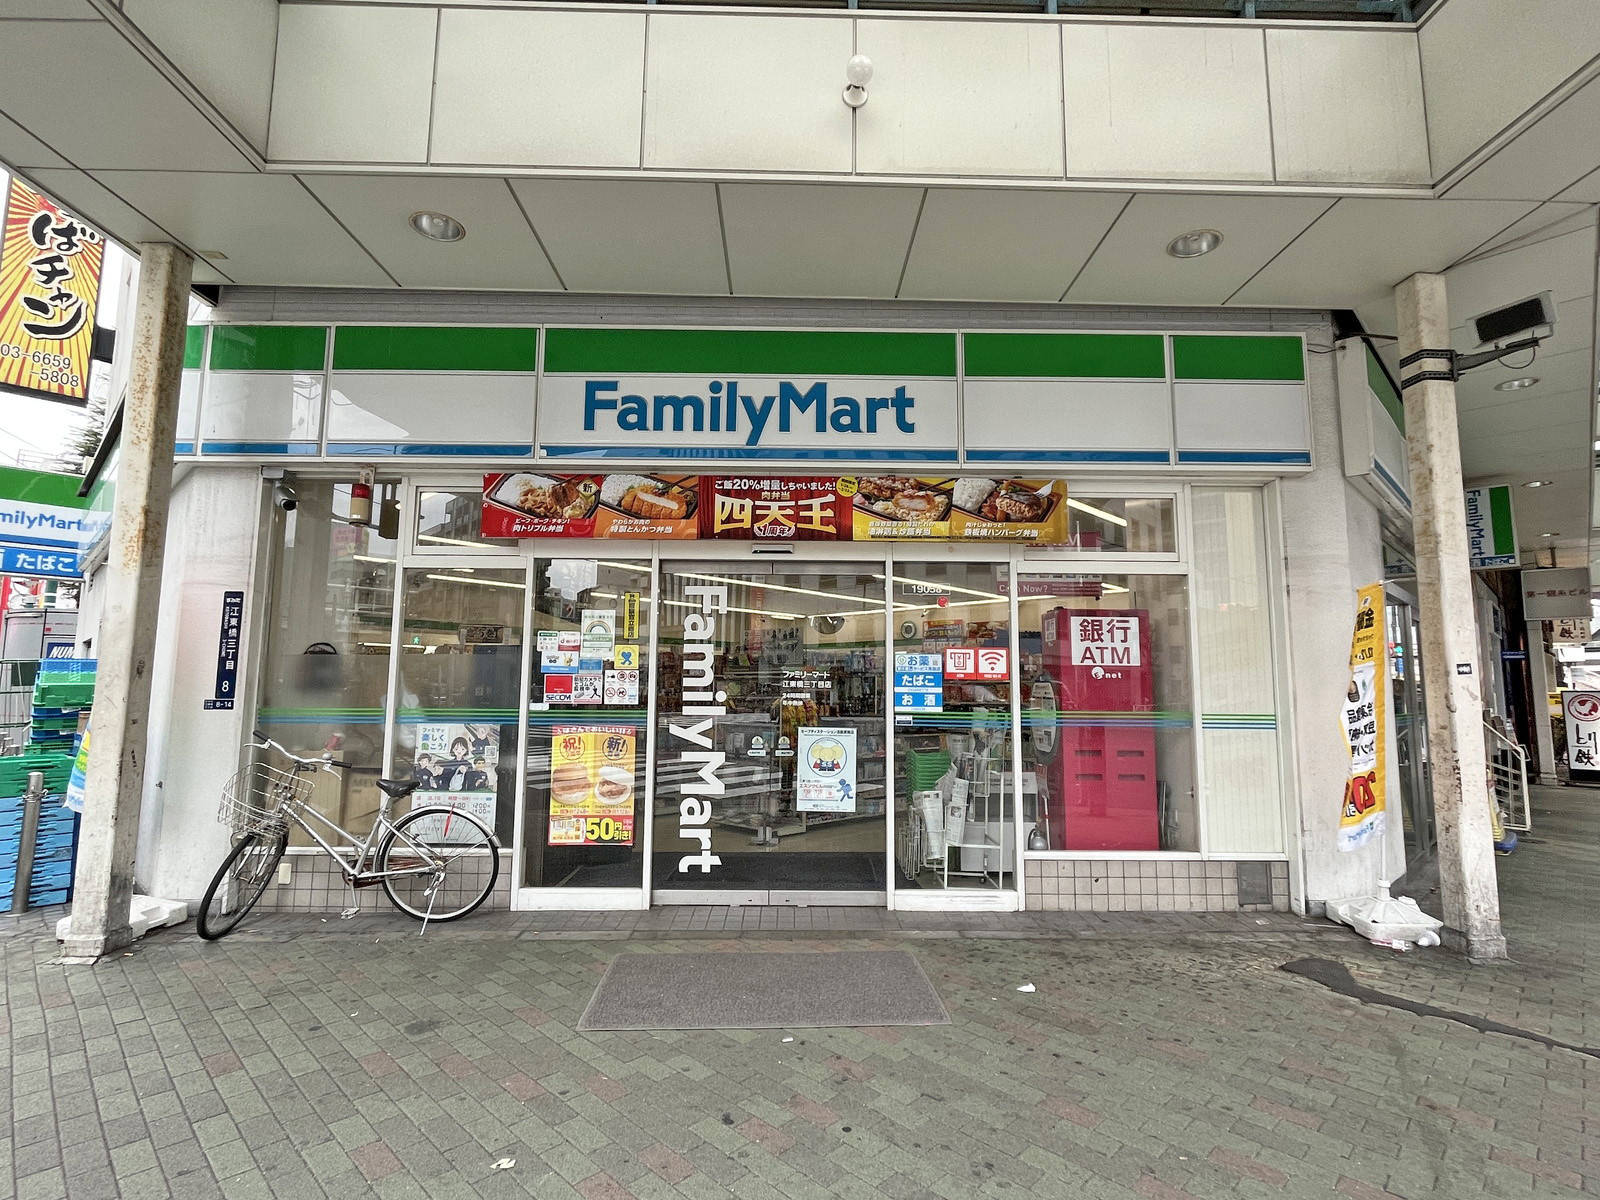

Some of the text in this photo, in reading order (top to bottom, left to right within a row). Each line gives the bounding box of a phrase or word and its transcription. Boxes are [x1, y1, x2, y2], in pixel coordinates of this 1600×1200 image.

[0, 343, 72, 370] 03-6659
[30, 367, 80, 389] -5808
[583, 380, 916, 447] FamilyMart
[582, 482, 593, 493] 新
[715, 479, 836, 490] ご飯20%増量しちゃいました!
[761, 491, 791, 500] 肉弁当
[714, 493, 837, 534] 四天王
[1466, 489, 1485, 557] FamilyMart
[512, 524, 564, 533] 肉トリプル弁当
[16, 552, 75, 574] たばこ
[225, 606, 240, 670] 江東橋三丁目
[1079, 618, 1131, 644] 銀行
[907, 655, 930, 666] お薬
[1080, 646, 1131, 664] ATM
[782, 670, 831, 679] ファミリーマート
[901, 674, 935, 686] たばこ
[221, 680, 229, 693] 8
[668, 585, 728, 874] FamilyMart
